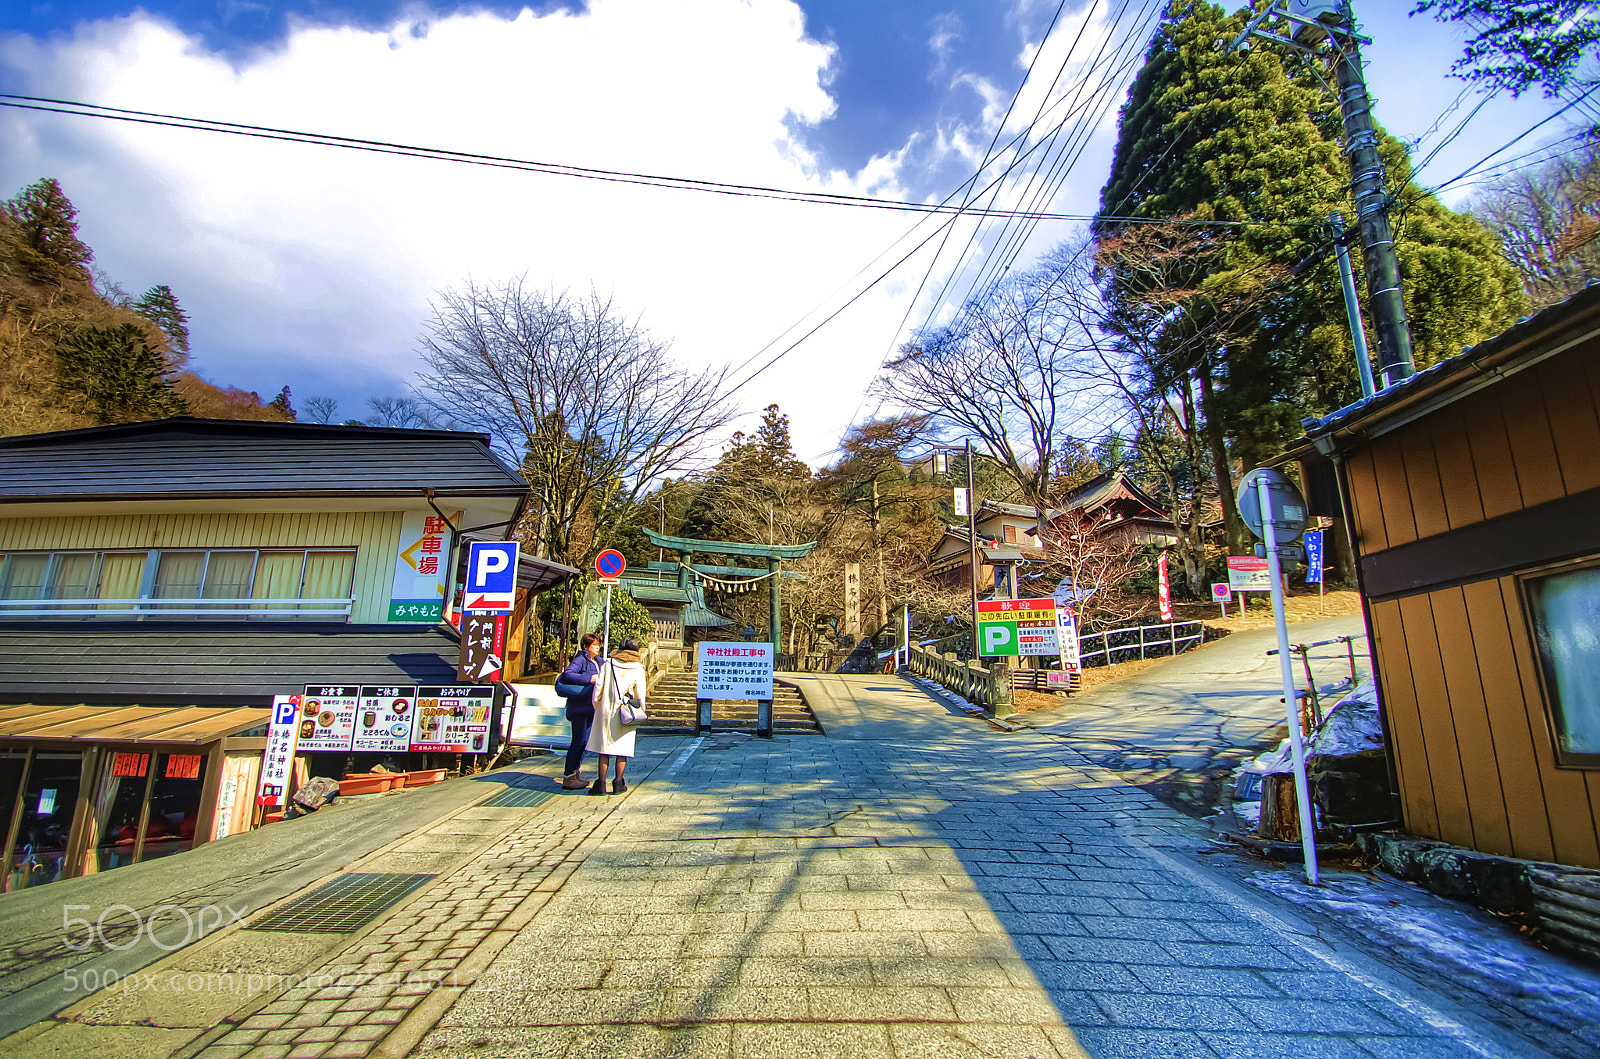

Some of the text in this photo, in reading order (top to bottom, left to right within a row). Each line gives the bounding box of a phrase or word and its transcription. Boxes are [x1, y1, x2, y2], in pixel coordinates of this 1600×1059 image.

[418, 516, 445, 575] 駐車場
[475, 549, 509, 587] P
[395, 604, 438, 617] みやもと
[1001, 602, 1031, 611] 歓迎
[980, 611, 1054, 620] この先広い駐車場有り
[1060, 614, 1070, 627] P
[480, 622, 493, 649] 門前
[985, 627, 1011, 653] P
[463, 618, 479, 676] クレープ
[706, 647, 766, 657] 神社社殿工事中
[320, 687, 345, 696] お食事
[376, 687, 400, 697] ご休憩
[440, 688, 472, 697] おみやげ
[277, 704, 295, 724] P
[385, 714, 411, 722] おしるこ
[274, 729, 291, 778] 榛名神社
